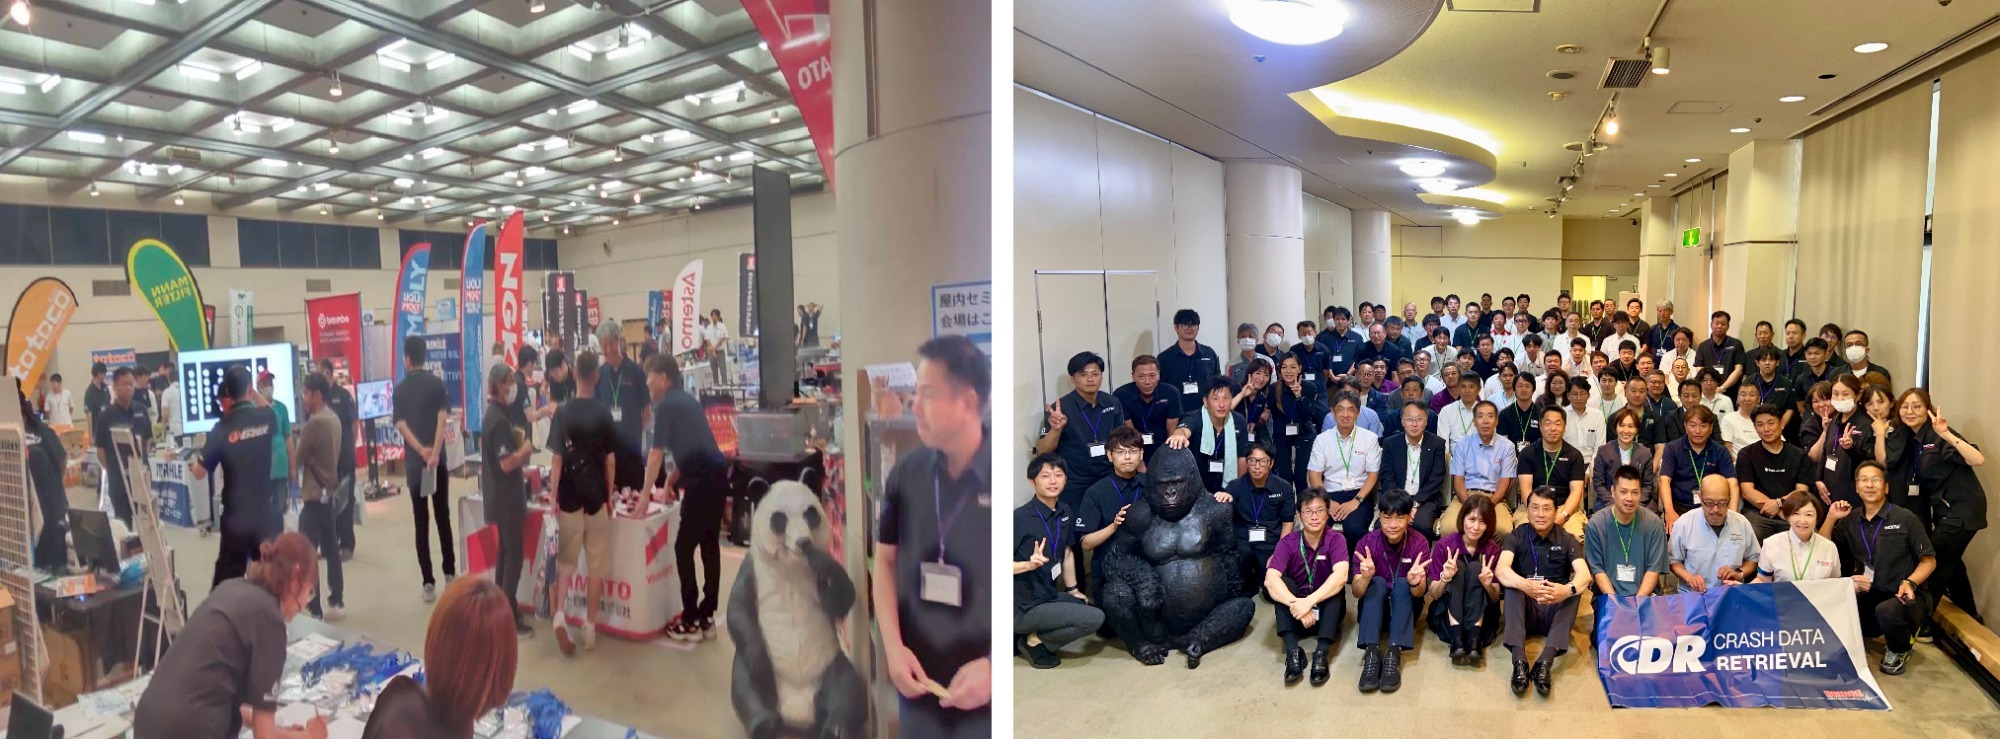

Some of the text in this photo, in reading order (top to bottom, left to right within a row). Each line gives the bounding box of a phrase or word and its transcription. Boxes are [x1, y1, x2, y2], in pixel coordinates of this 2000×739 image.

[405, 259, 427, 336] MLY
[939, 291, 991, 308] 屋内セミ
[500, 253, 519, 369] NGK
[940, 313, 991, 329] 会場はこ
[1713, 628, 1825, 650] CRASH DATA
[1610, 635, 1707, 674] CDR
[1717, 651, 1827, 671] RETRIEVAL
